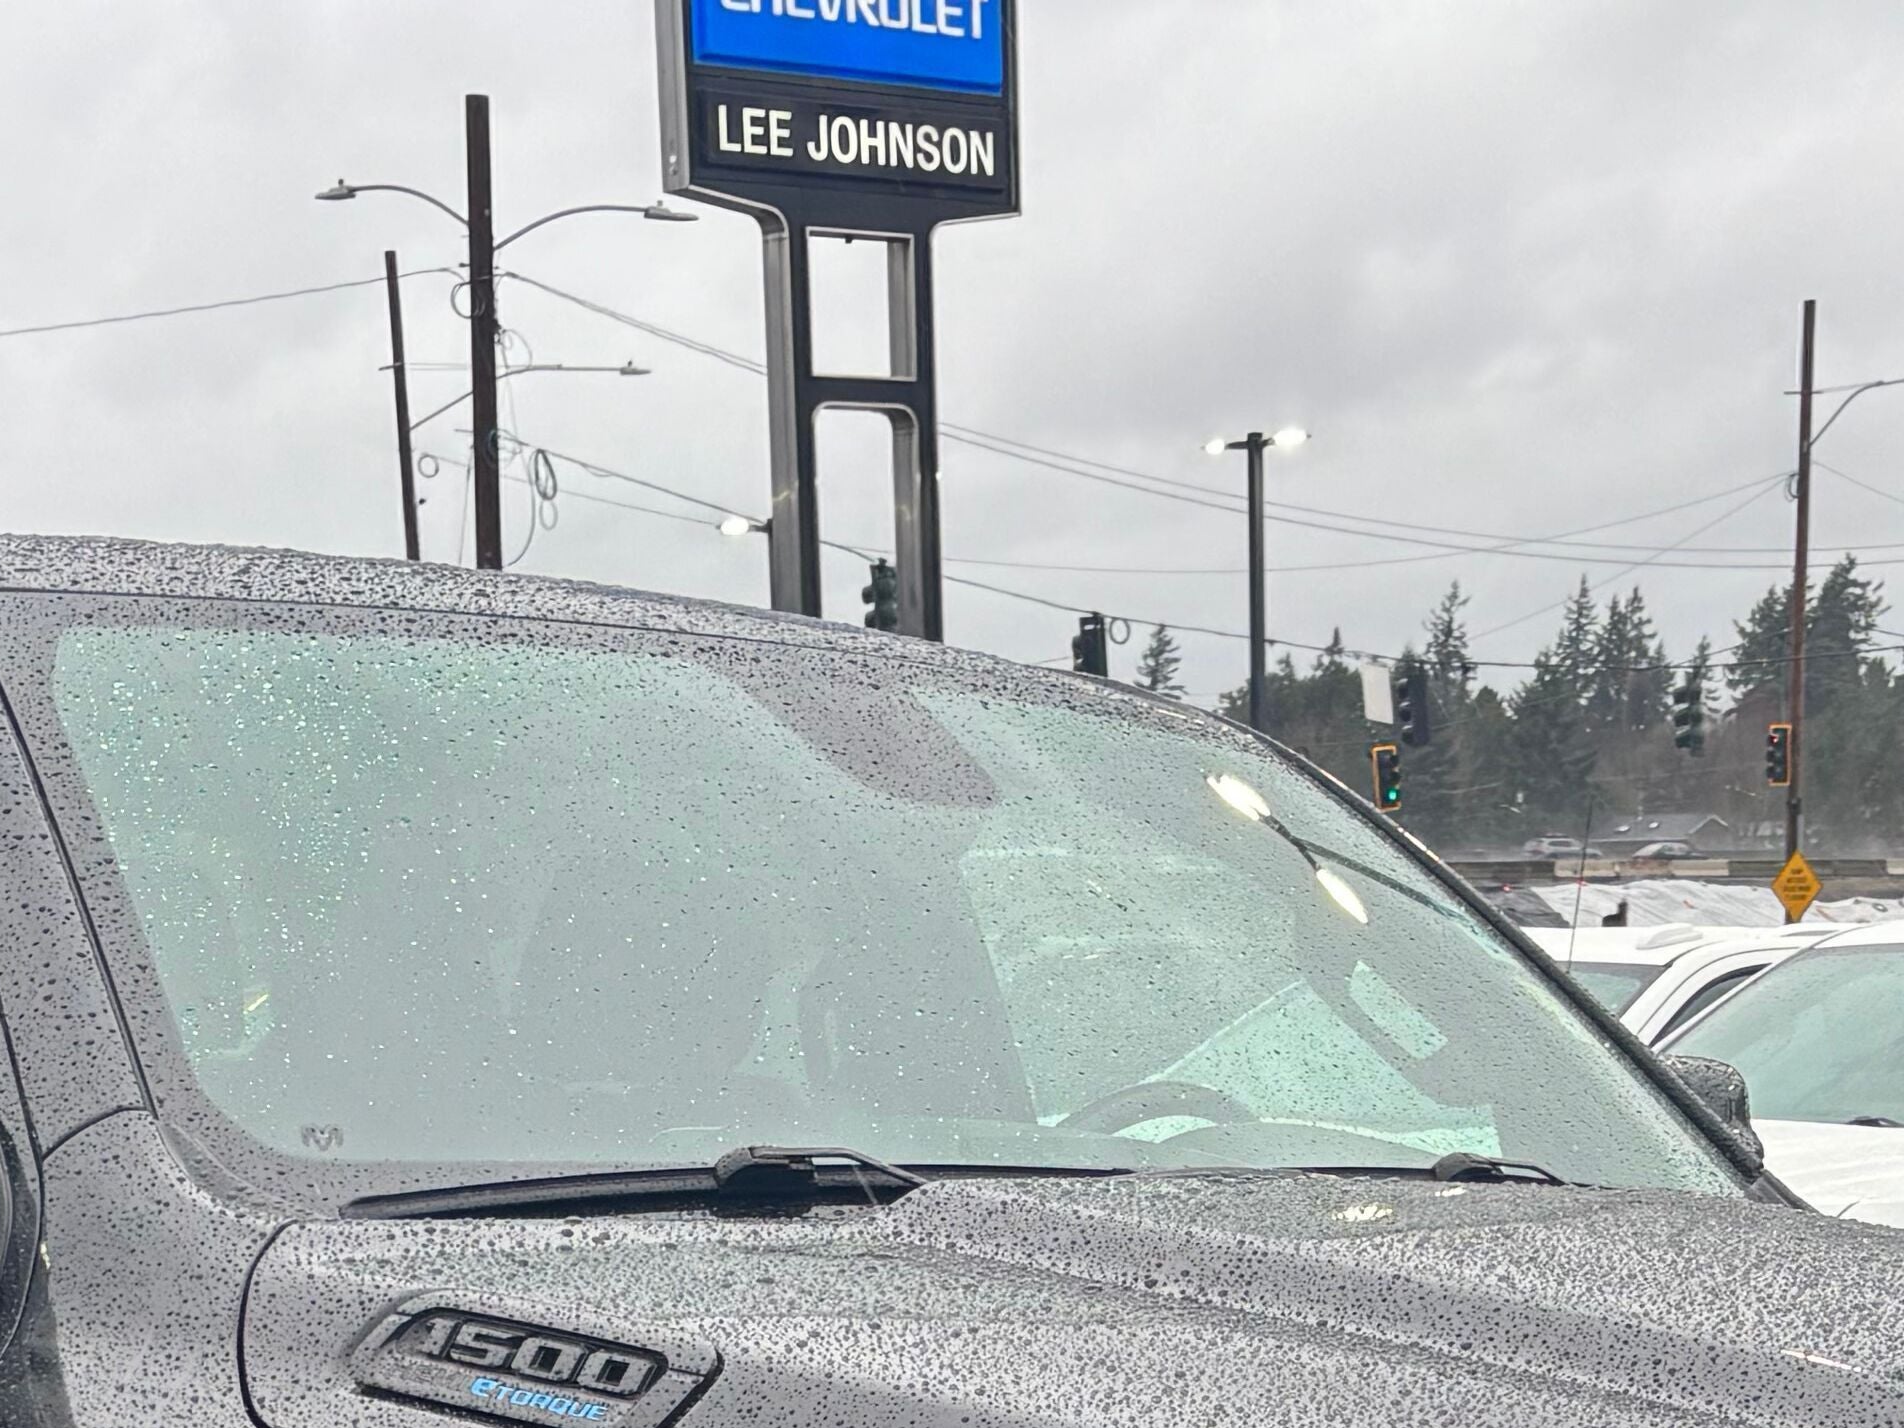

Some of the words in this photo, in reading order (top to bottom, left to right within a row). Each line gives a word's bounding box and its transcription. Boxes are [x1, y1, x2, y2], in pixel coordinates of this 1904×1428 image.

[720, 0, 989, 40] VROLET
[718, 104, 793, 157] LEE
[806, 114, 994, 177] JOHNSON
[421, 1316, 657, 1396] 1500
